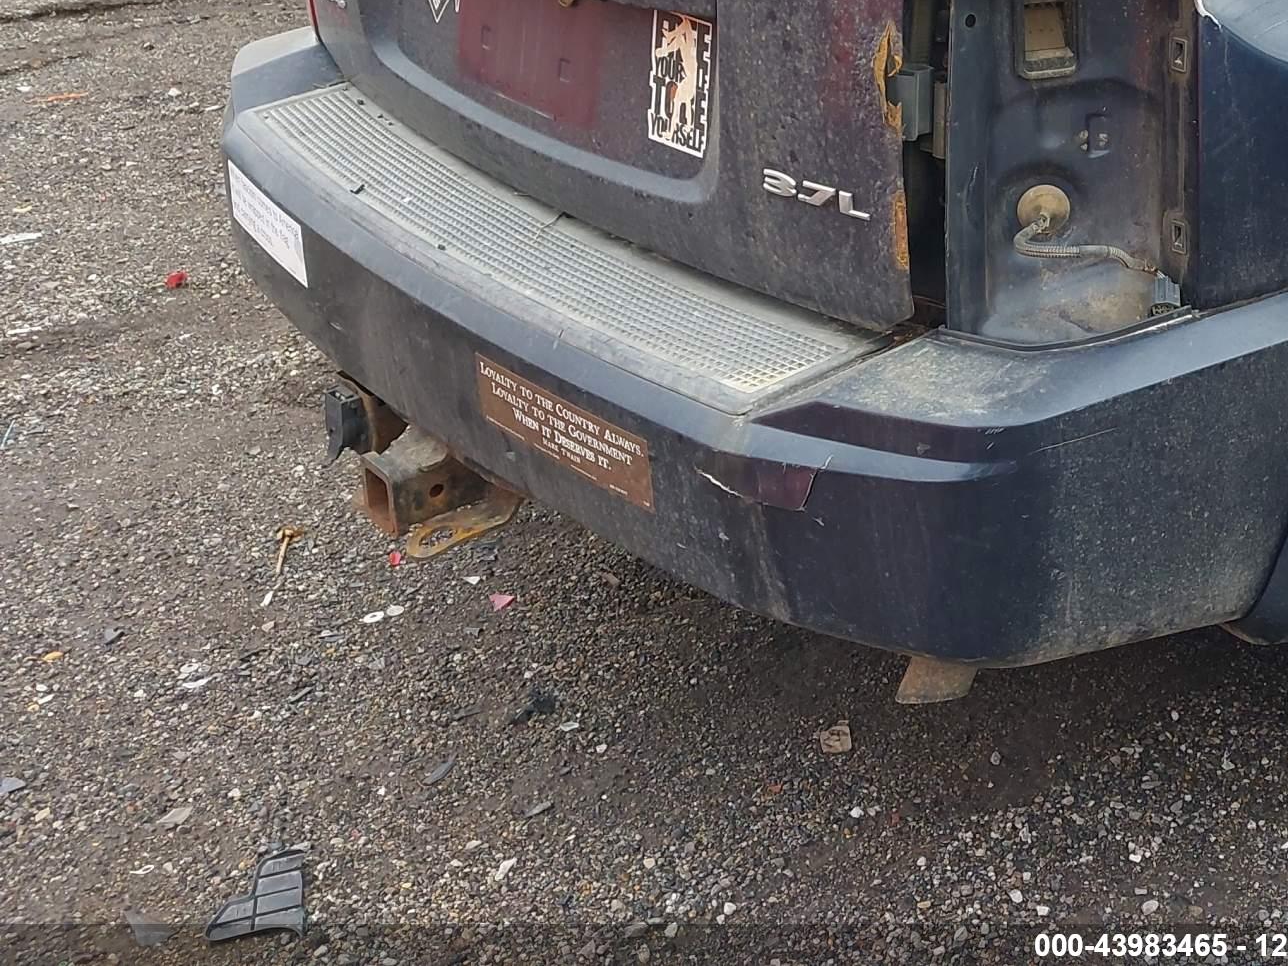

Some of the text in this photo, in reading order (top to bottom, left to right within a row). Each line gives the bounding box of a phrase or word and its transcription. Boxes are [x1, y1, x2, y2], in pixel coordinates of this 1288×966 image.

[479, 361, 518, 392] LOYALTY
[520, 385, 533, 401] TO
[535, 393, 554, 412] THE
[556, 403, 600, 436] COUNTRY
[491, 382, 529, 412] LOYALTY
[531, 405, 545, 421] TO
[547, 414, 566, 433] THE
[568, 425, 633, 466] GOVERNMENT
[512, 407, 540, 432] WHEN
[542, 424, 551, 439] IT
[554, 431, 596, 463] DESERVES
[542, 437, 559, 453] MARK
[561, 447, 582, 464] TWAIN
